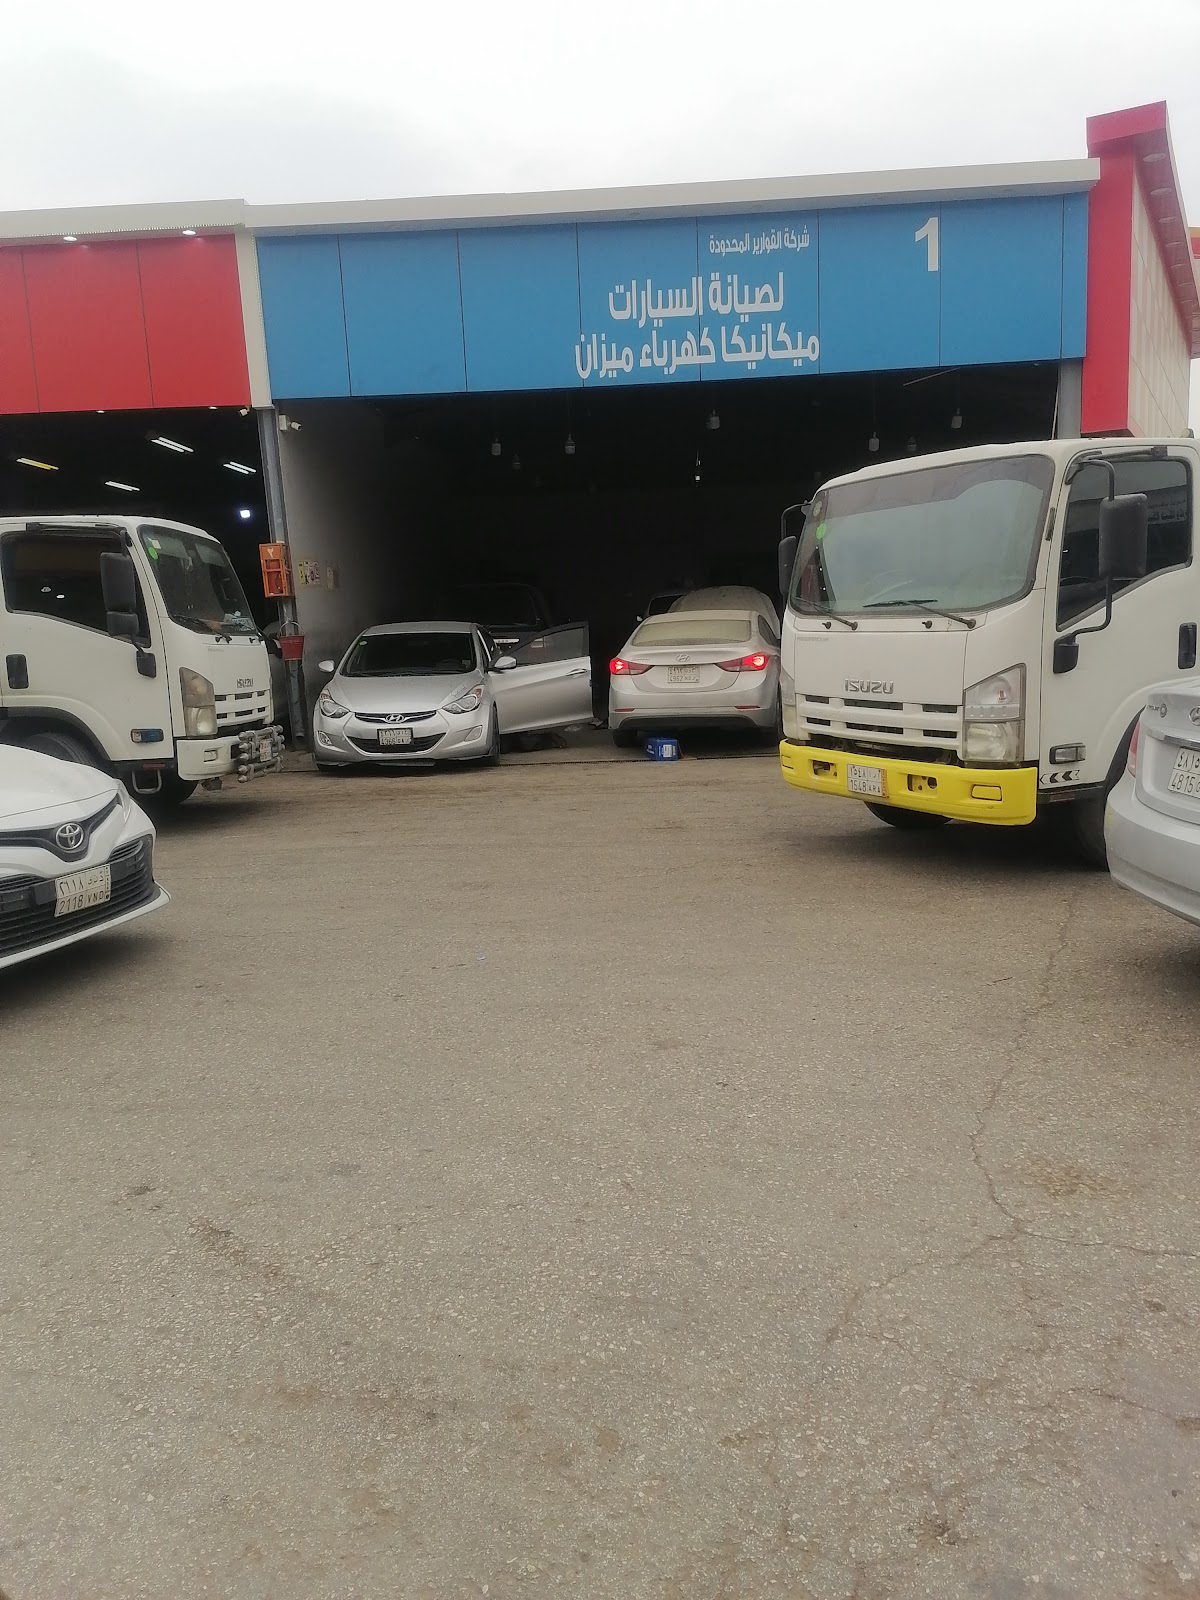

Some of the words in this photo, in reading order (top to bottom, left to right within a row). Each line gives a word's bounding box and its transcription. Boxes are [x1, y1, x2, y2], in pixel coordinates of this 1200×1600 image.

[709, 233, 750, 257] المحدودة
[752, 229, 782, 255] القوارير
[784, 225, 810, 252] شركة
[914, 217, 939, 272] 1
[608, 276, 703, 328] السيارات
[708, 272, 784, 323] لصيانة
[575, 333, 634, 379] ميزان
[640, 327, 716, 374] كهرباء
[721, 322, 820, 370] ميكانيكا
[845, 679, 894, 694] ISUZU
[850, 780, 867, 793] 1548
[1171, 773, 1196, 793] 4815
[59, 895, 84, 914] 2118
